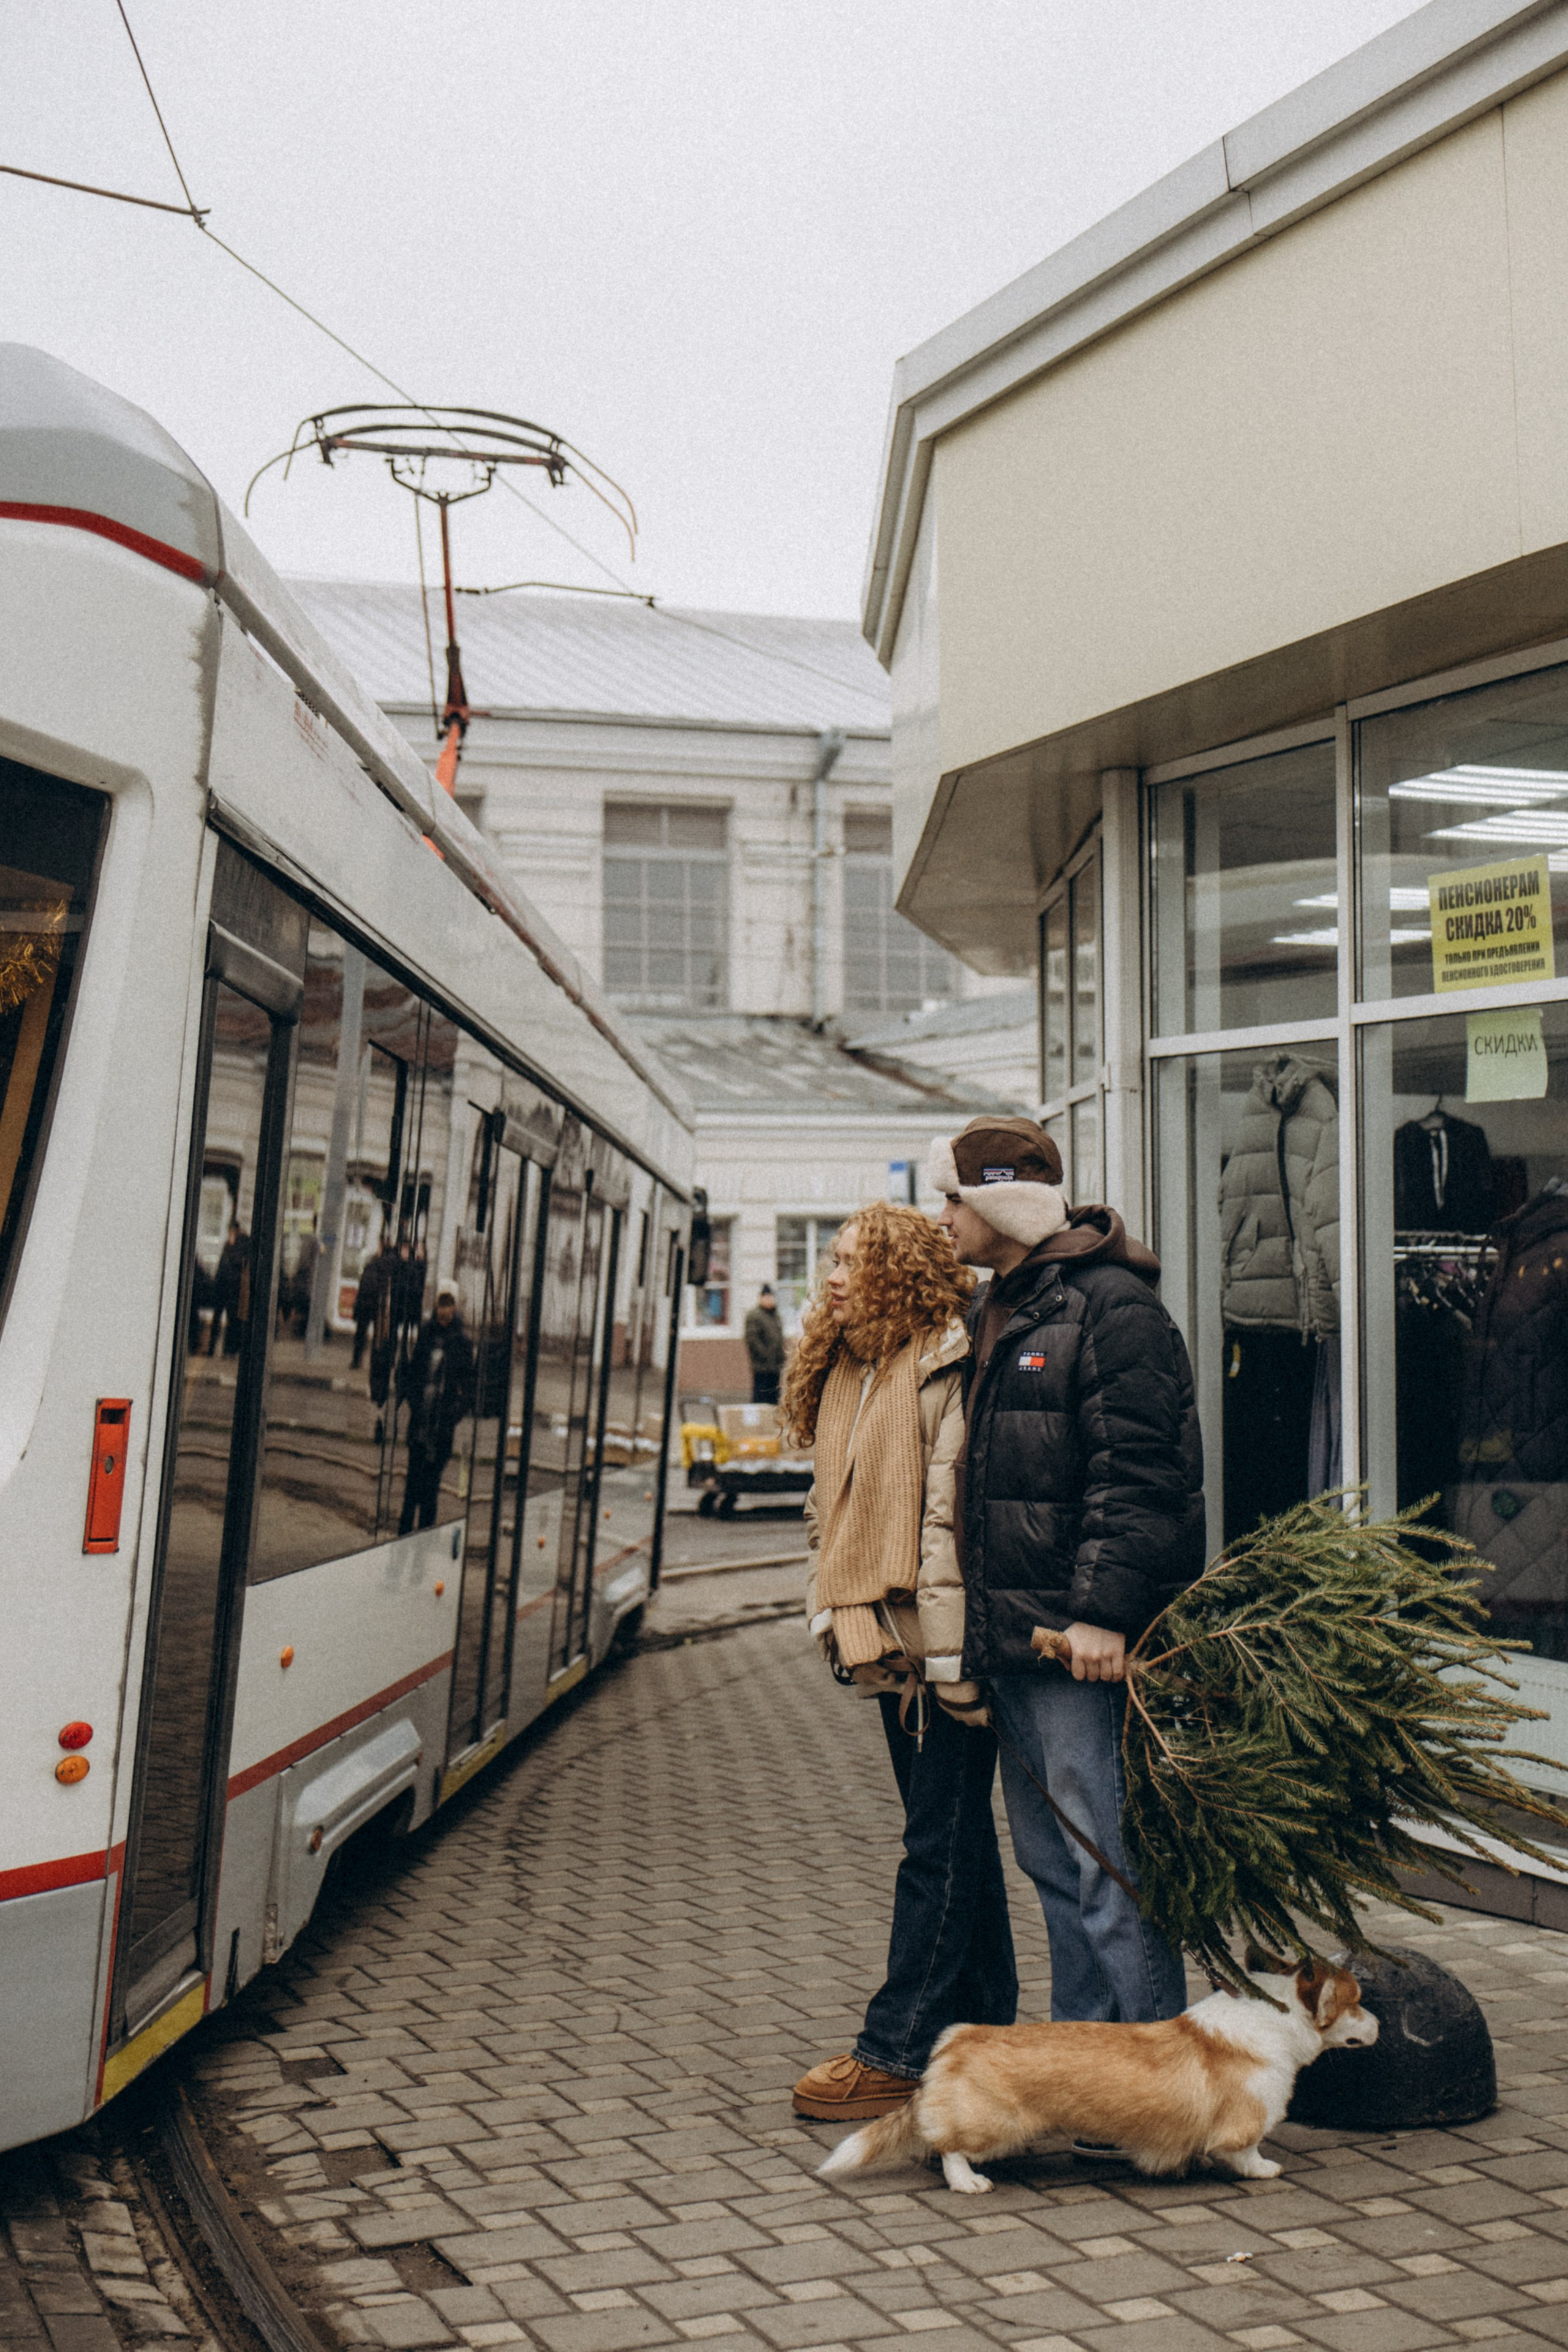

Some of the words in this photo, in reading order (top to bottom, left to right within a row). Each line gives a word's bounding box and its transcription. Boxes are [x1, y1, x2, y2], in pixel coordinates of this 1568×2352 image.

[1439, 870, 1540, 911] ПЕНСИОНЕРАМ
[1446, 909, 1504, 941] СКИДКА
[1506, 903, 1537, 933] 20%
[1445, 951, 1471, 965] ТОЛЬКО
[1472, 948, 1486, 961] ПРИ
[1487, 941, 1540, 959] ПРЕДЪЯВЛЕНИИ
[1441, 965, 1489, 982] ПЕНСИОННОГО
[1489, 957, 1545, 978] УДОСТОВЕРЕНИЯ
[1474, 1033, 1538, 1058] СКИДКИ
